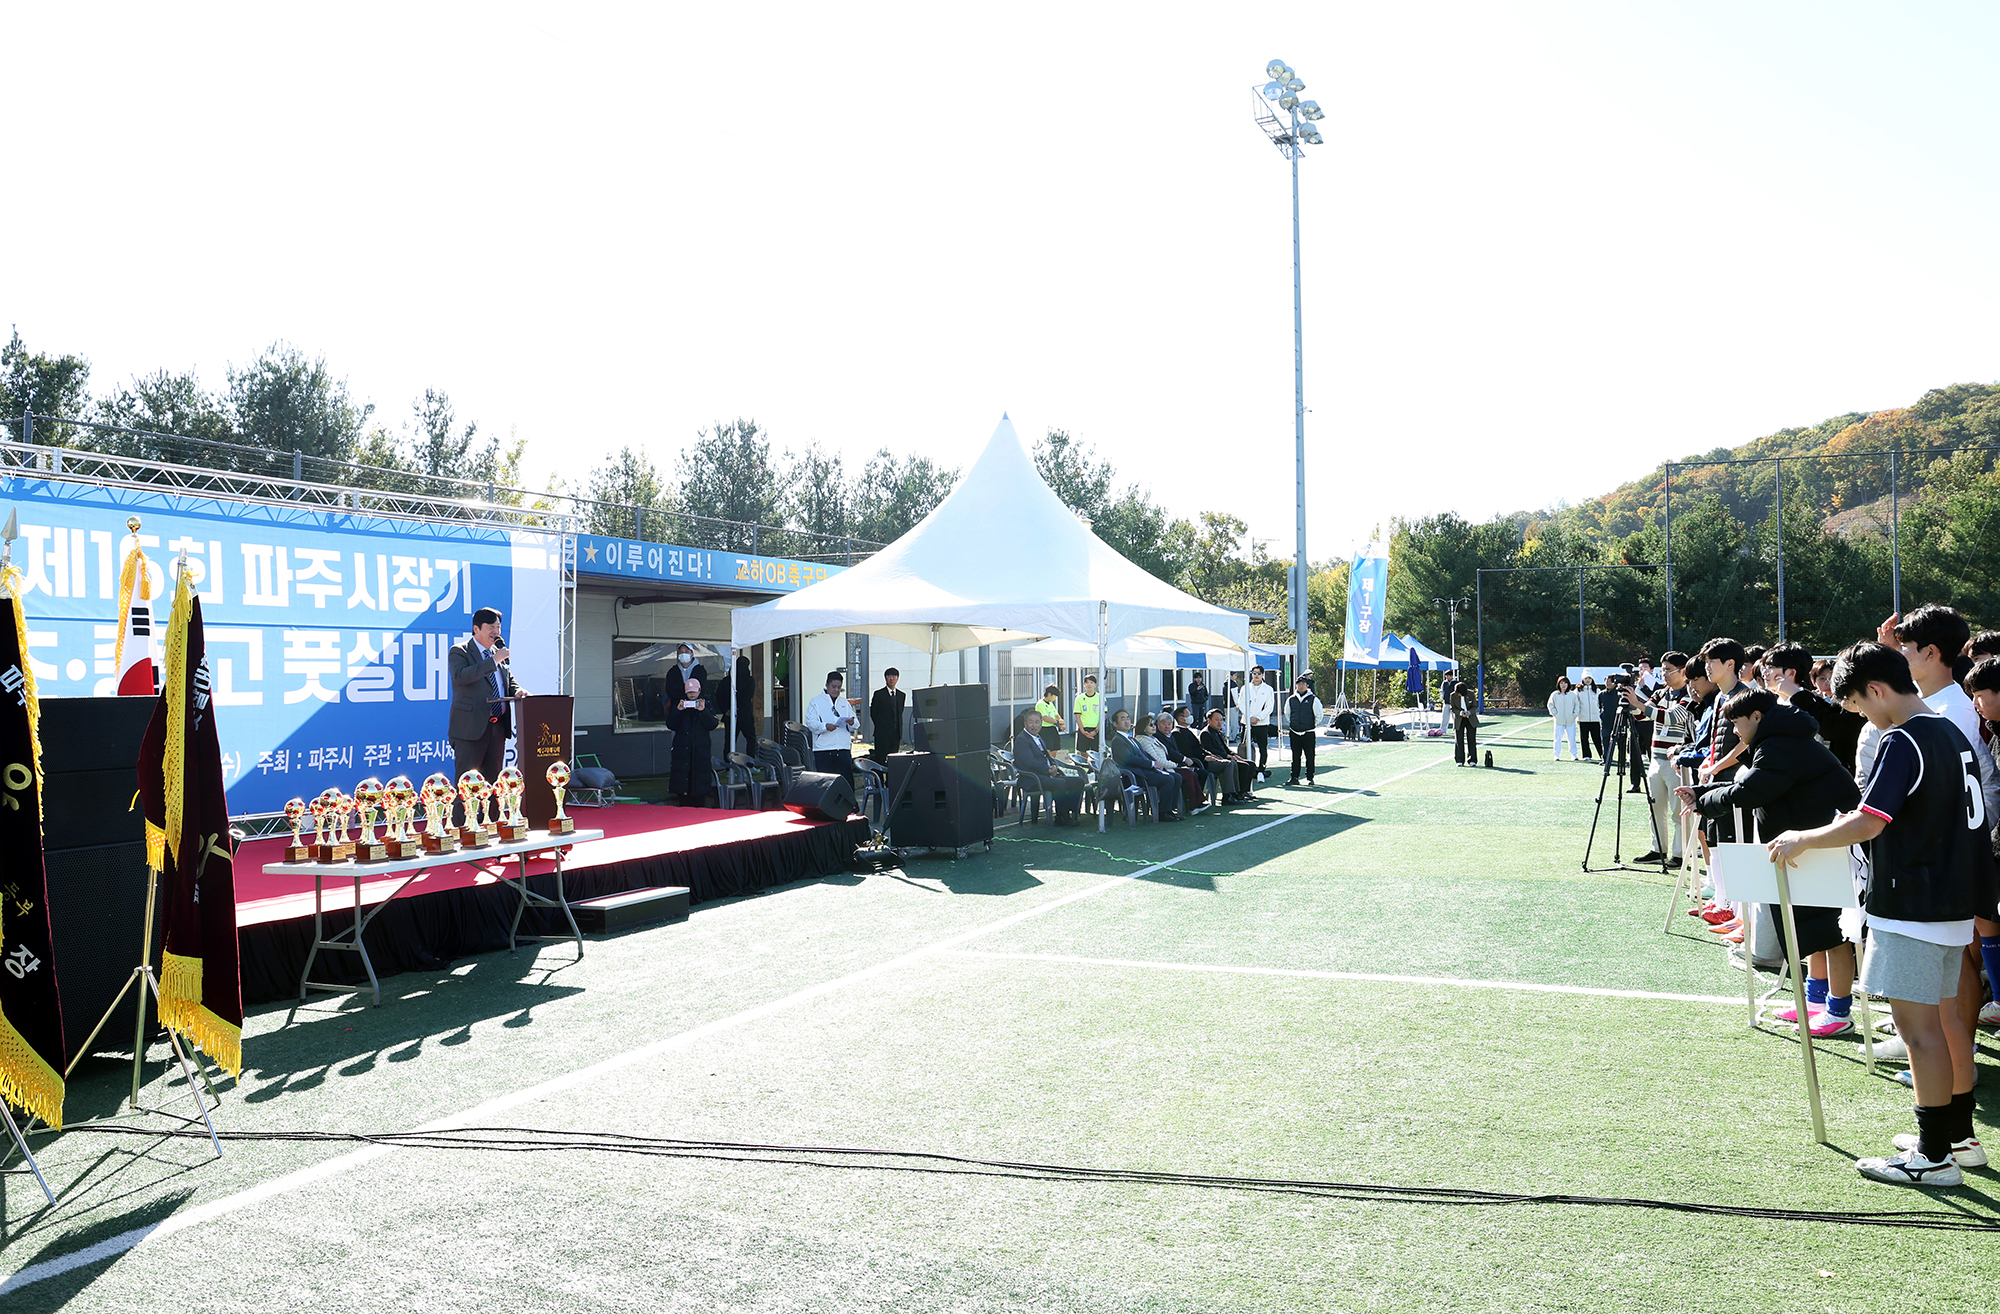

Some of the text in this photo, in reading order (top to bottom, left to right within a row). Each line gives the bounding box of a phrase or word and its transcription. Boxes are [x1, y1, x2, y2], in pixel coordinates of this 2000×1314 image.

[241, 543, 472, 614] 파주시장기
[605, 542, 712, 579] 이루어진다!
[1358, 578, 1375, 634] 제1구장
[283, 629, 473, 705] 풋살대
[221, 750, 242, 778] 수)
[257, 749, 290, 775] 주최
[308, 745, 354, 771] 파주시
[363, 743, 392, 767] 주관
[1960, 750, 1985, 830] 5
